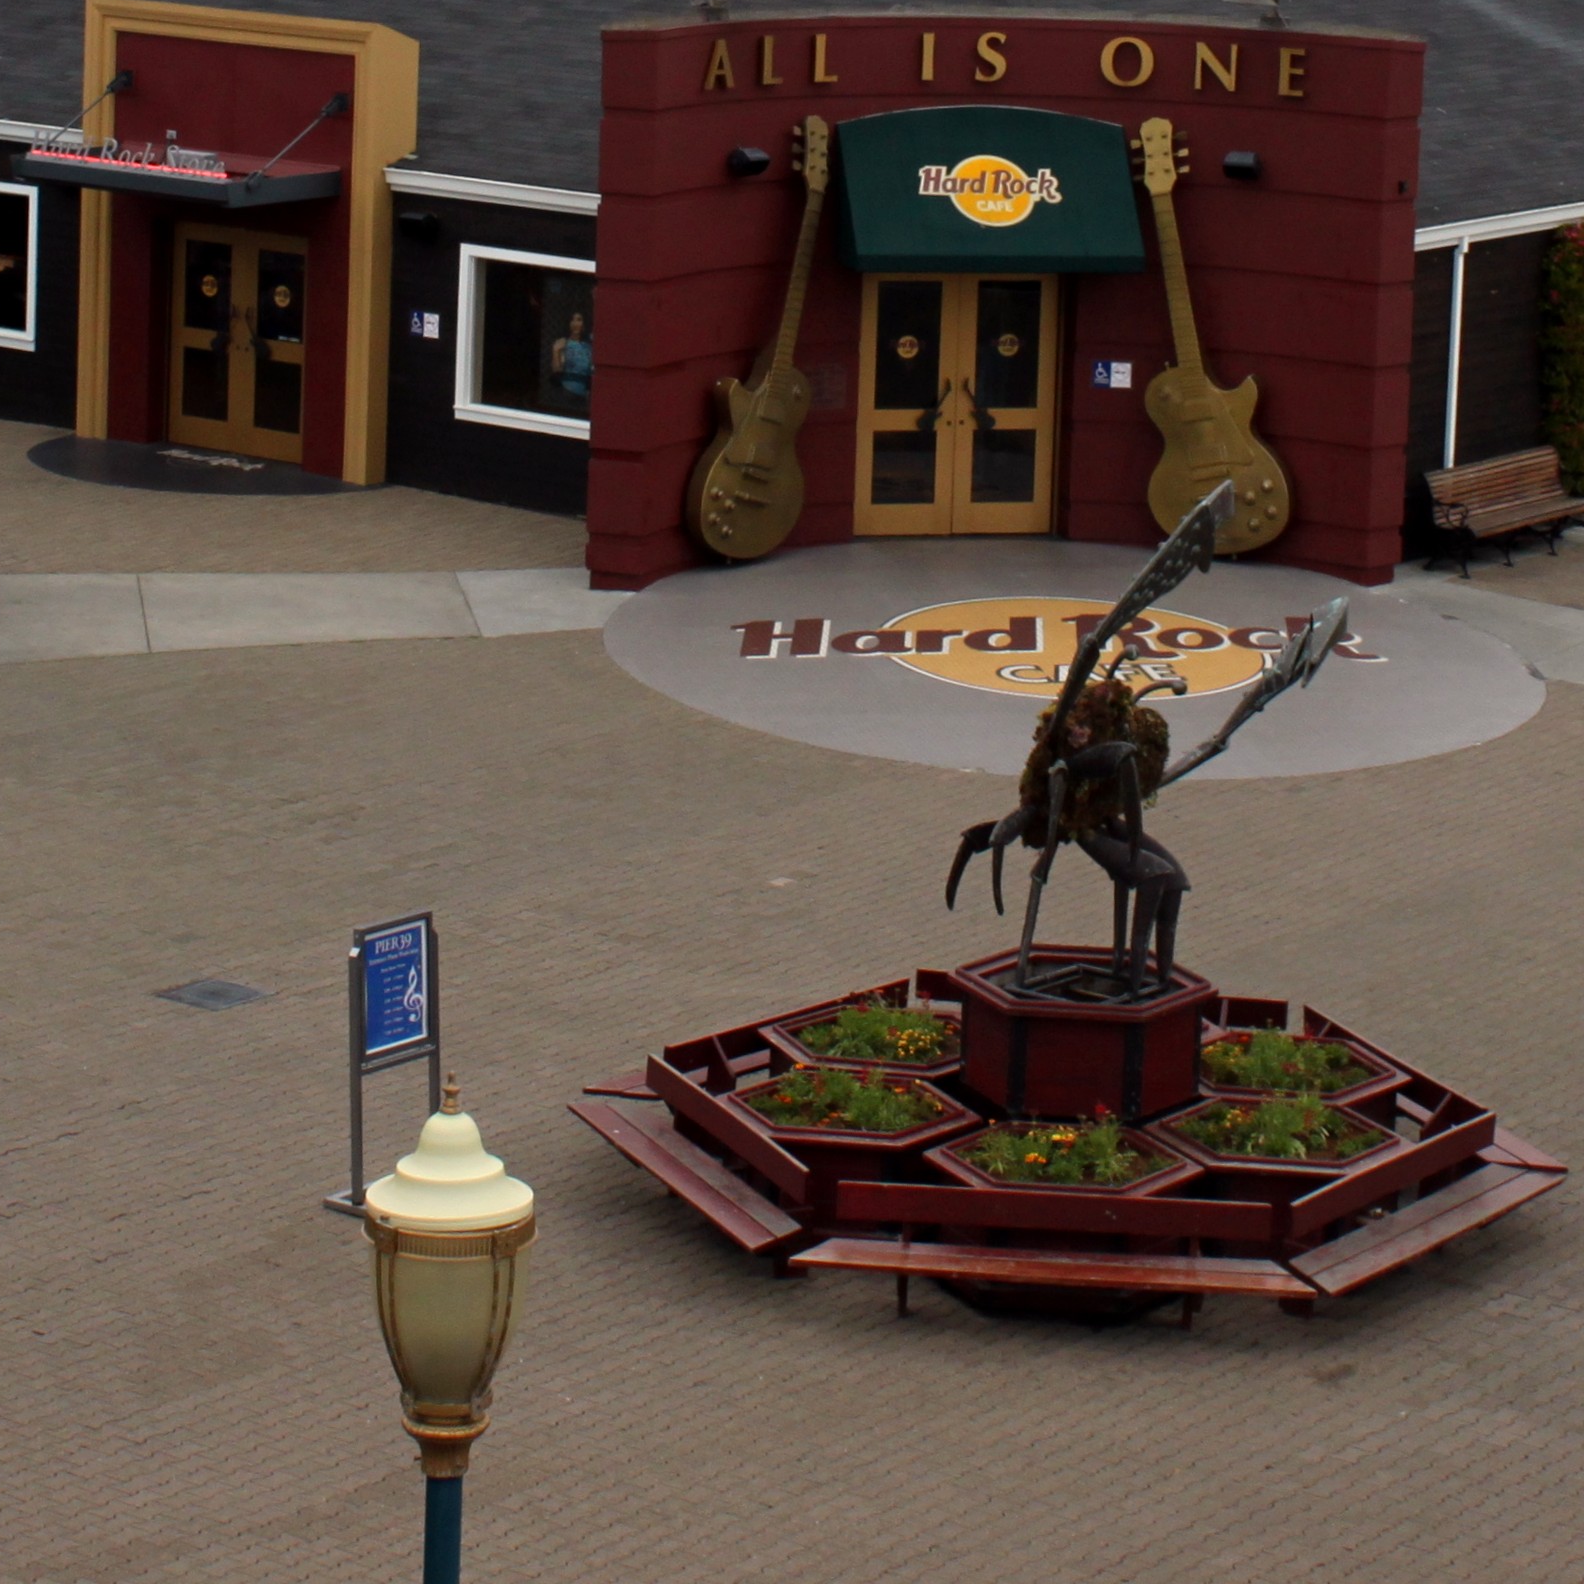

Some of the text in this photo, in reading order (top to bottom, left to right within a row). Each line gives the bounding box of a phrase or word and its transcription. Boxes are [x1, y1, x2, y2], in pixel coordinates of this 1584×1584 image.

[703, 31, 1308, 99] ALL IS ONE
[100, 136, 156, 168] Rock
[163, 144, 225, 174] Store
[919, 166, 1060, 202] Hard Rock
[976, 199, 1014, 213] CAFE
[730, 615, 1045, 660] Hard
[375, 932, 413, 955] PIER 39
